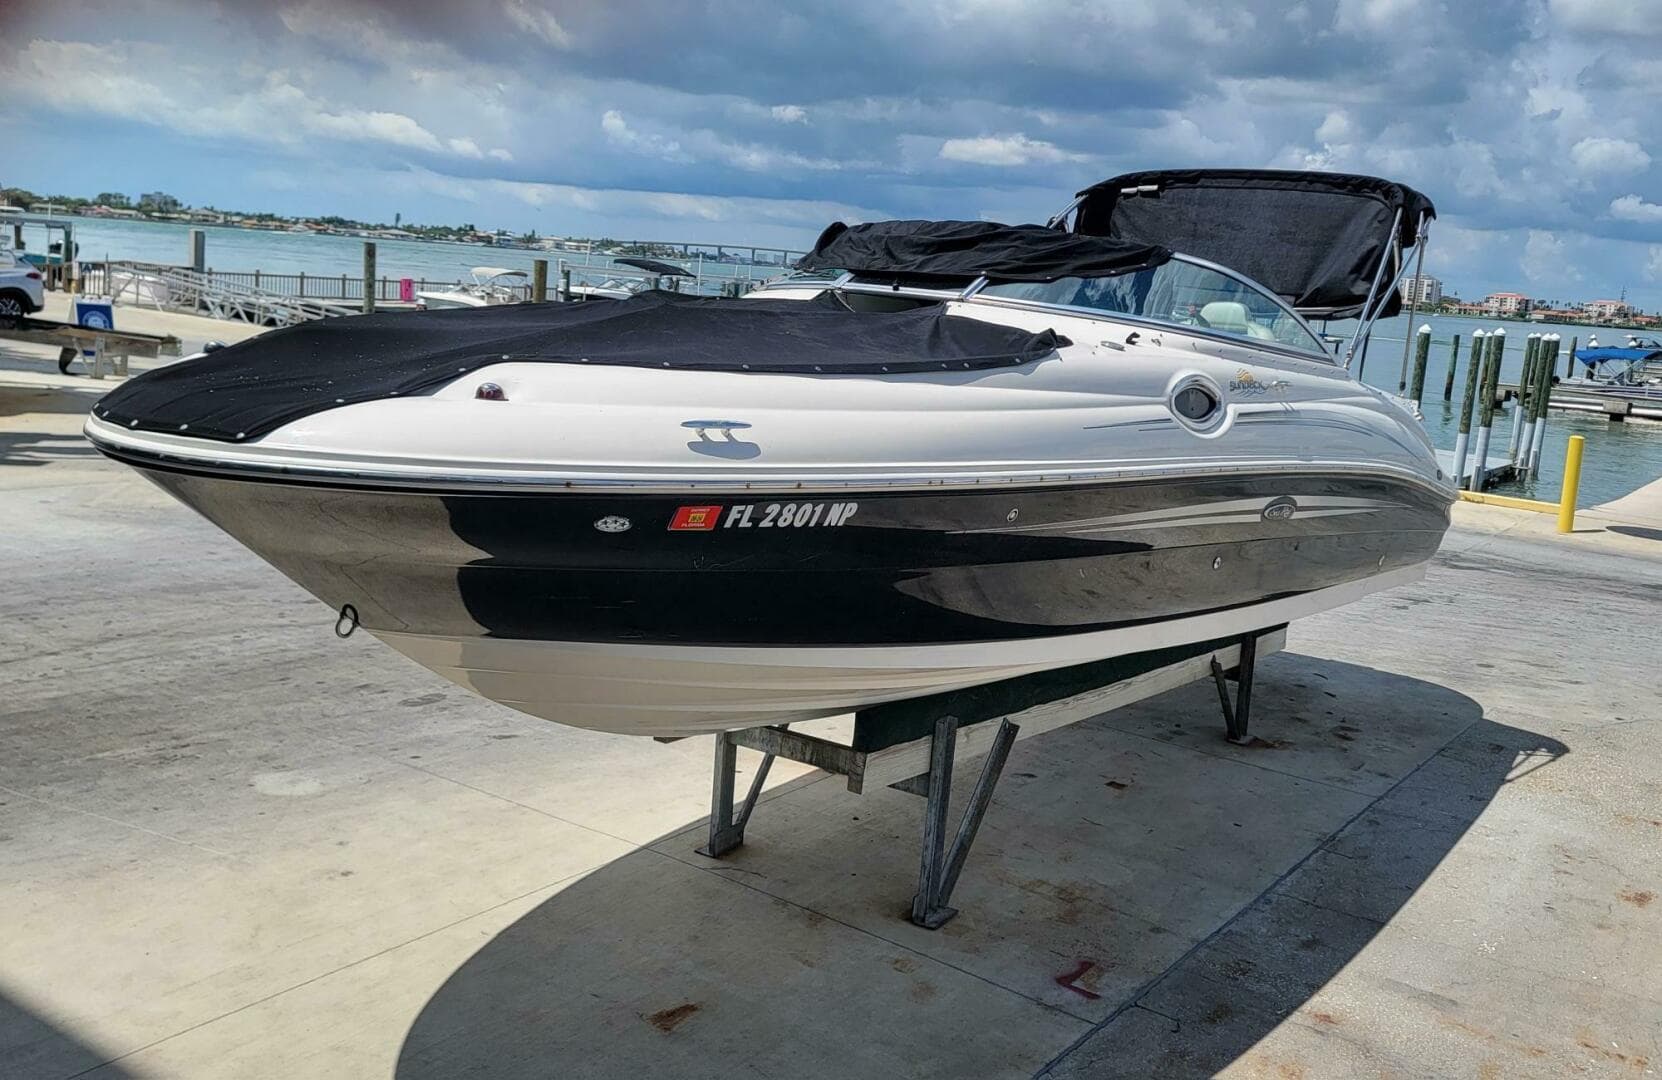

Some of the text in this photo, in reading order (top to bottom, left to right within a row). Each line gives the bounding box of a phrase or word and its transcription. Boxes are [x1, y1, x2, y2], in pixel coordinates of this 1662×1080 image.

[723, 502, 859, 528] FL 2801 NP
